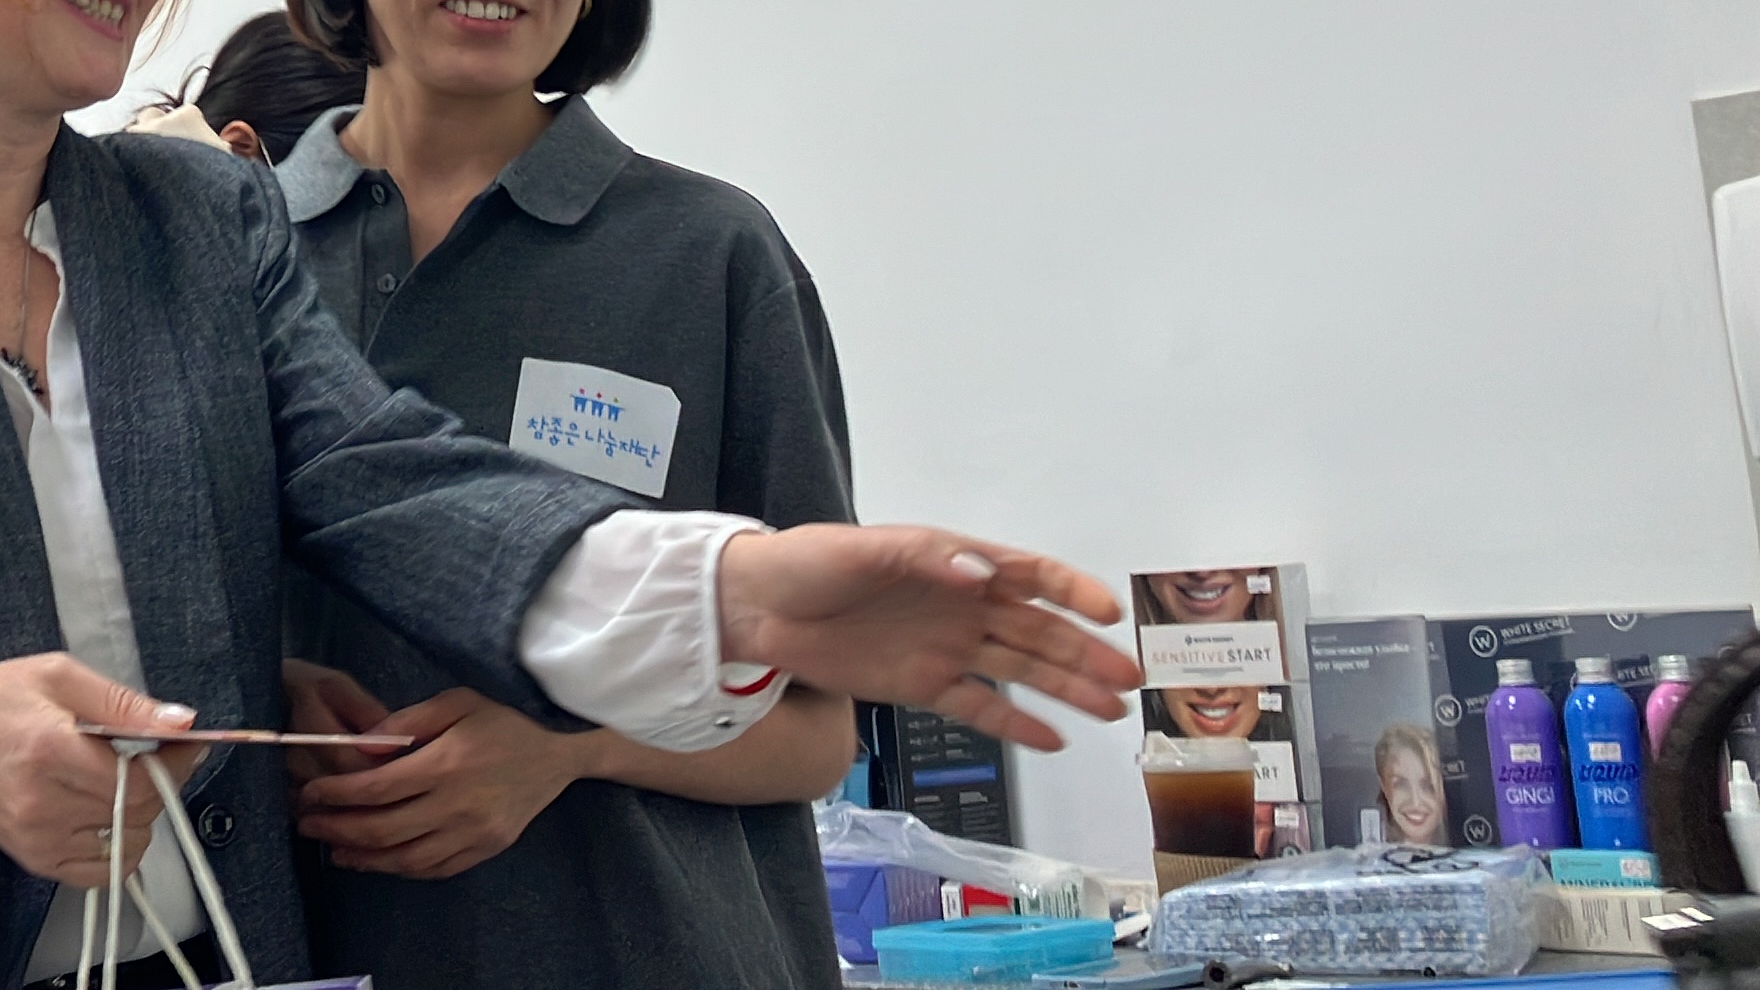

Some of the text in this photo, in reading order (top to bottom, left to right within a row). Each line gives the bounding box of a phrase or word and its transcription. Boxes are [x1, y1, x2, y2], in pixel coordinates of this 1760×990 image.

[1151, 647, 1272, 664] SENSITIVE START
[1593, 786, 1630, 805] PRO
